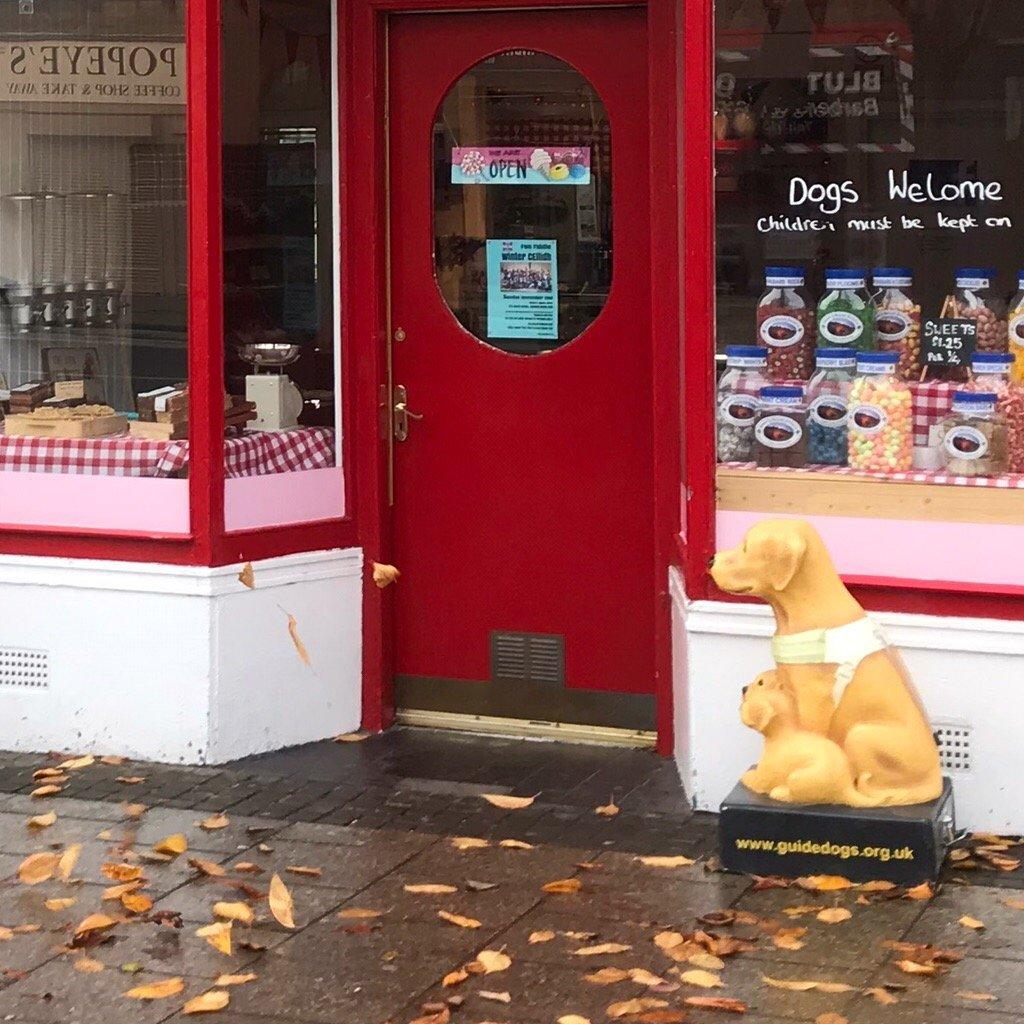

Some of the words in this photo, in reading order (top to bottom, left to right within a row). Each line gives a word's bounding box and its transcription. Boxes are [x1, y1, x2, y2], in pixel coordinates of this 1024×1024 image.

[489, 159, 526, 179] OPEN
[789, 177, 859, 214] Dogs
[847, 216, 892, 231] must
[901, 215, 924, 230] be
[937, 212, 978, 233] kept
[985, 217, 1012, 228] on
[925, 321, 976, 337] SWEETS
[736, 837, 915, 862] www.guidedogs.org.uk
